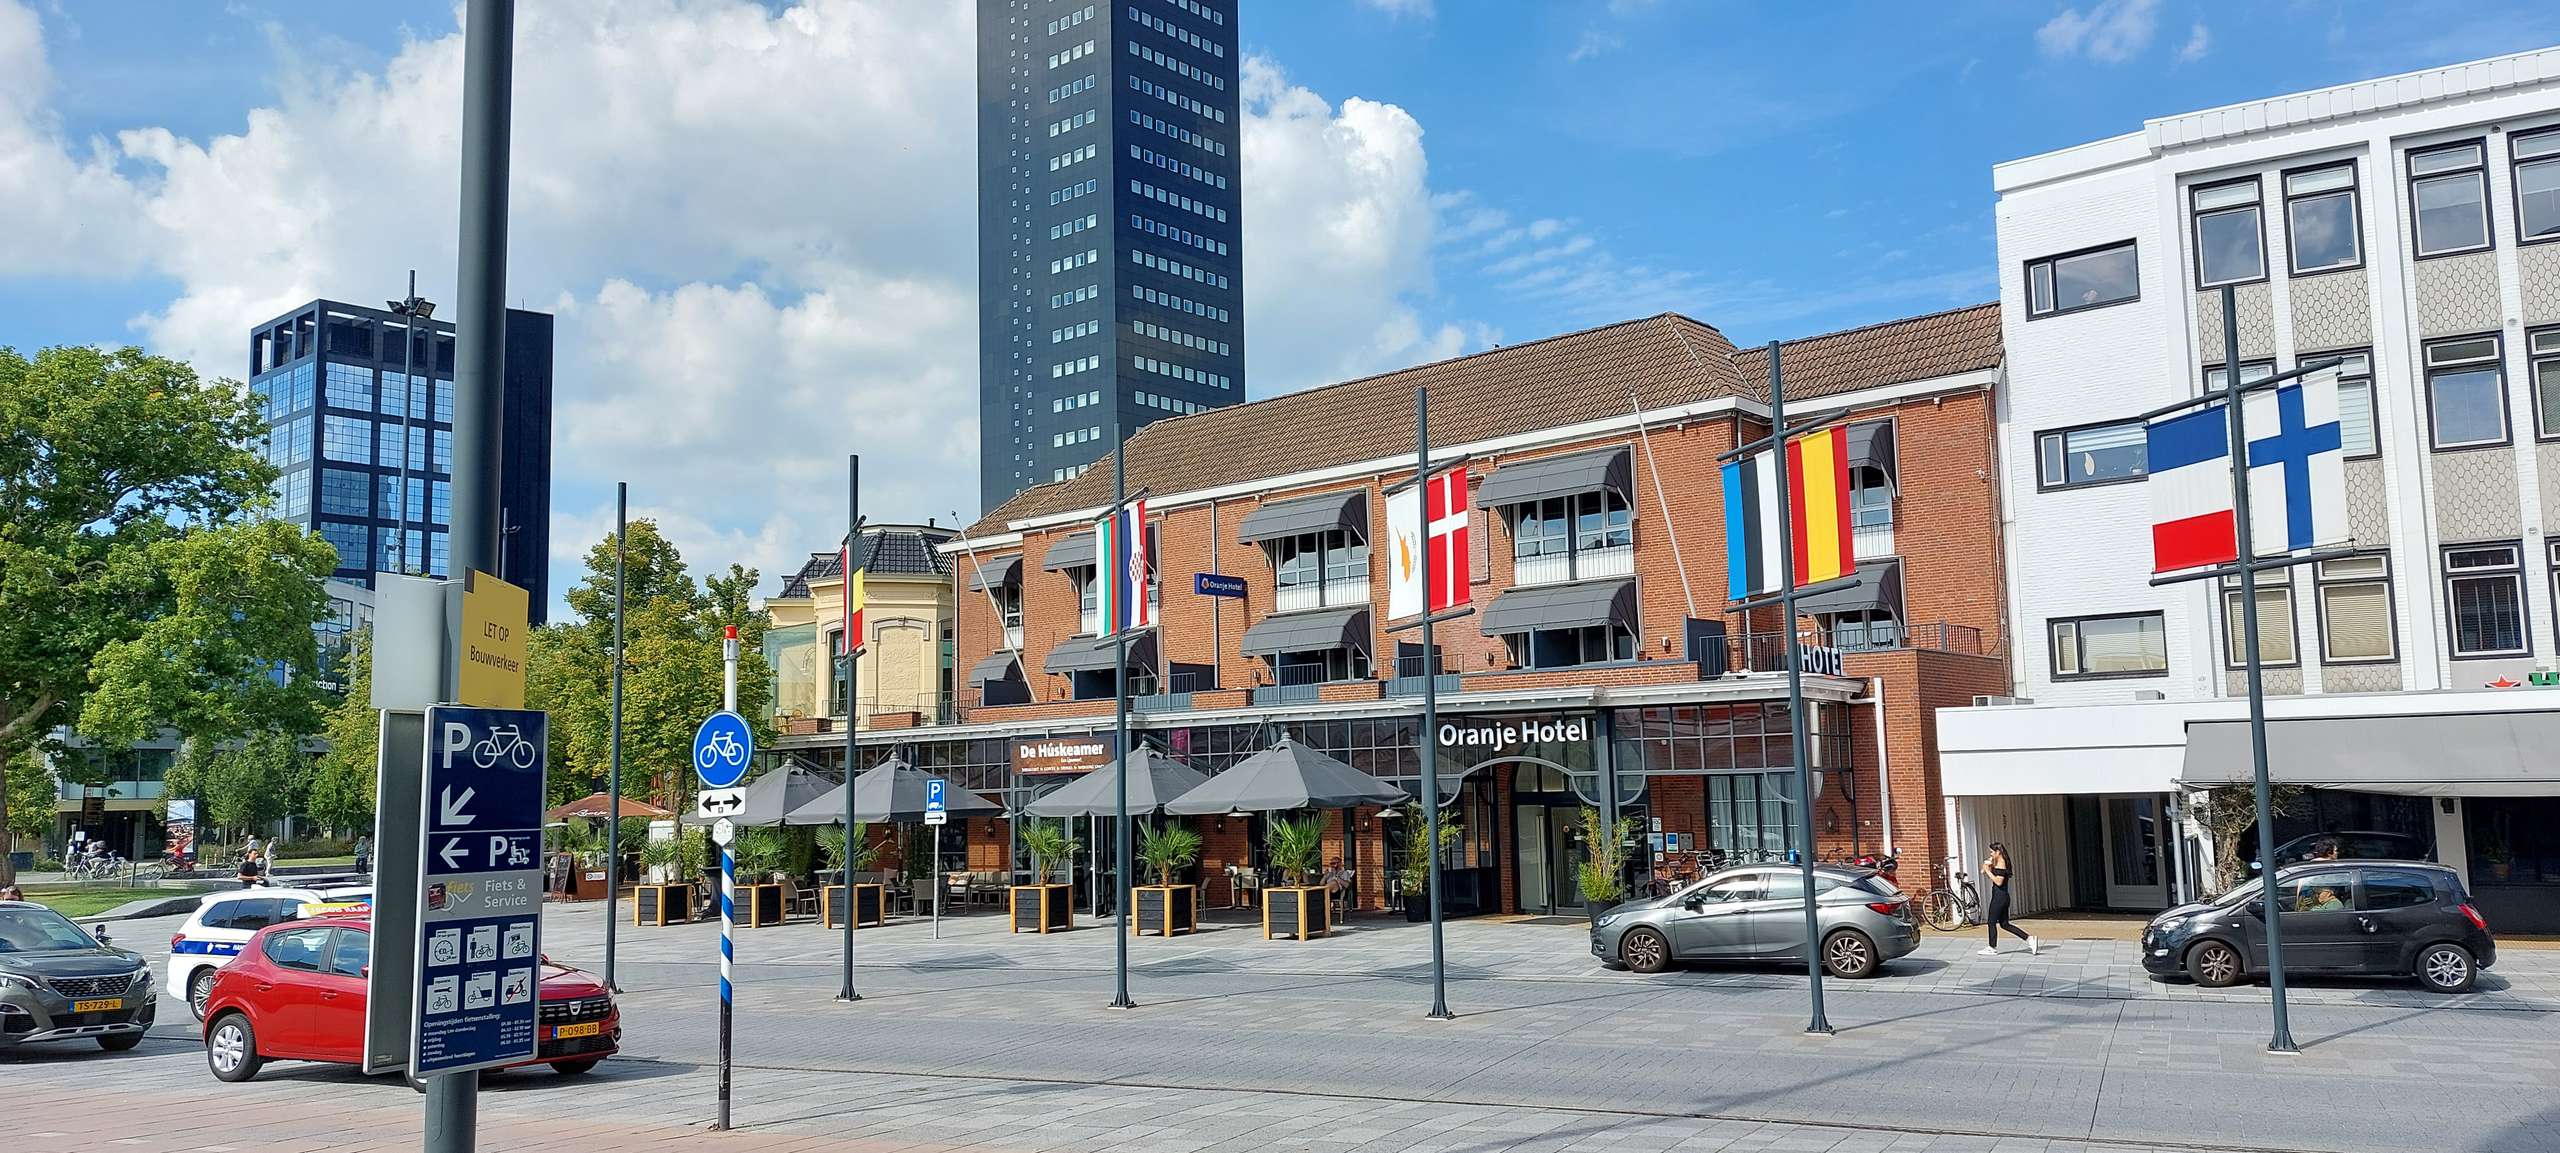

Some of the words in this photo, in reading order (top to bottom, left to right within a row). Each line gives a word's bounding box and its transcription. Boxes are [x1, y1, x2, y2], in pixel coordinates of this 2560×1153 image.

[1210, 581, 1228, 591] Oranje
[1228, 583, 1243, 591] Hotel
[484, 620, 498, 639] LET
[499, 626, 510, 643] OP
[470, 645, 519, 672] Bouwverkeer
[1800, 643, 1848, 677] HOTEL
[443, 722, 472, 769] P
[1439, 722, 1517, 751] Oranje
[1521, 717, 1588, 743] Hotel
[1020, 745, 1037, 759] De
[1038, 742, 1105, 758] Húskeamer
[930, 783, 941, 800] P
[489, 835, 508, 867] P
[485, 880, 513, 892] Fiets
[517, 878, 526, 890] &
[484, 894, 527, 908] Service
